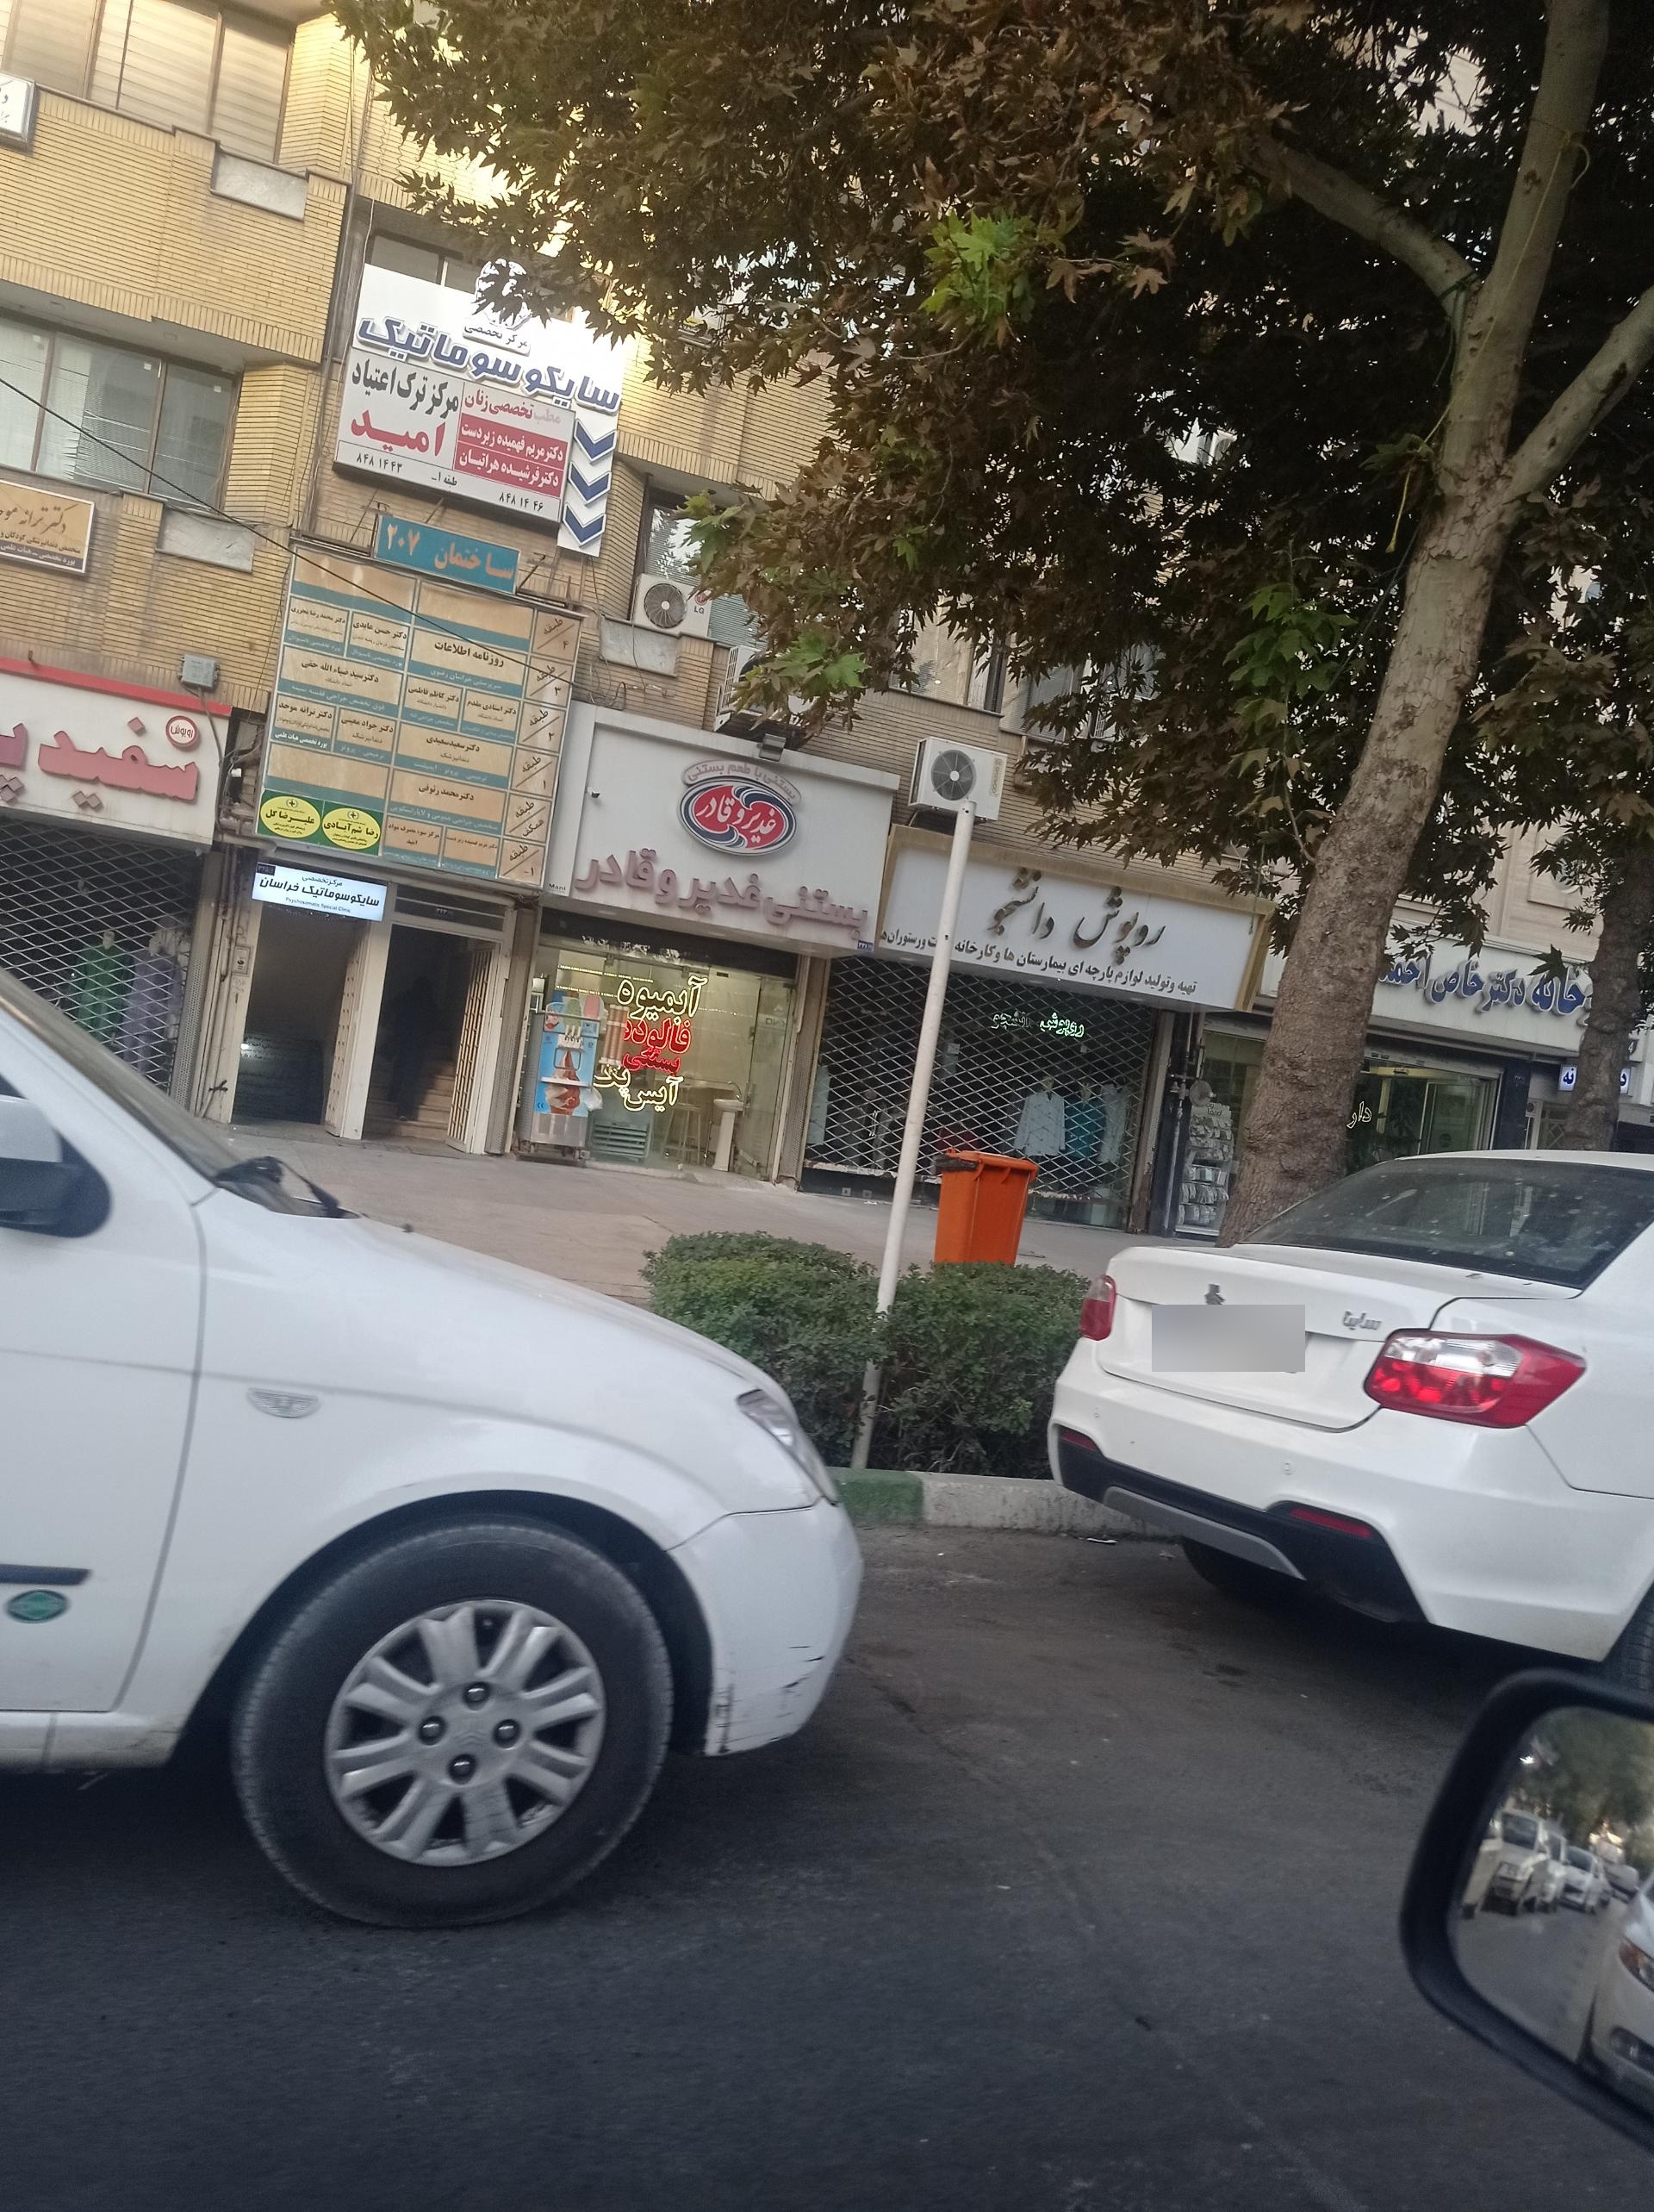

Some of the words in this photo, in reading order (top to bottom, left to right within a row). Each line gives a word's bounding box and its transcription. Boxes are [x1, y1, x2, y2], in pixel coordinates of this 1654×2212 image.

[351, 358, 397, 396] اعتیاد
[396, 371, 429, 411] ترک
[425, 381, 459, 420] مرکز
[464, 389, 489, 413] زنان
[489, 402, 534, 420] تخصصی
[351, 409, 446, 457] امید
[496, 435, 526, 454] فهمیده
[525, 443, 545, 461] مریم
[543, 445, 564, 463] دکتر
[356, 452, 375, 466] ۸۴۸
[458, 448, 501, 474] هراتیان
[443, 473, 457, 489] طبقه
[500, 462, 540, 485] فرشیده
[538, 470, 560, 488] دکتر
[499, 490, 517, 506] ۸۴۸
[18, 506, 49, 527] ترانه
[40, 503, 79, 534] دکتر
[433, 541, 514, 580] ساختمان
[693, 606, 705, 614] LG
[392, 630, 407, 640] دکتر
[543, 618, 563, 635] طبقه
[433, 640, 471, 657] اطلاعات
[320, 662, 333, 672] الله
[472, 650, 505, 668] روزنامه
[363, 674, 379, 682] دکتر
[535, 664, 556, 682] طبقه
[277, 702, 298, 713] موحد
[445, 694, 459, 703] دکتر
[299, 707, 316, 716] ترانه
[315, 711, 333, 720] دکتر
[529, 708, 549, 727] طبقه
[464, 743, 481, 752] دکتر
[521, 755, 542, 773] طبقه
[728, 758, 752, 775] طعم
[458, 792, 475, 801] دکتر
[515, 800, 535, 819] طبقه
[695, 794, 735, 823] قادر
[731, 807, 746, 826] و
[365, 826, 379, 839] رضا
[521, 819, 544, 837] همکف
[740, 807, 777, 844] غدیر
[509, 843, 529, 862] طبقه
[574, 847, 657, 892] قادر
[258, 876, 300, 892] خراسان
[302, 875, 328, 884] تخصصی
[326, 878, 344, 888] مرکز
[656, 868, 677, 905] و
[302, 885, 381, 907] سایکوسوماتیک
[677, 873, 763, 916] غدیر
[764, 885, 869, 941] بستنی
[1073, 886, 1166, 966] روپوش
[1003, 947, 1016, 963] ها
[1017, 951, 1067, 974] بیمارستان
[1067, 961, 1084, 976] ای
[1085, 964, 1114, 984] پارچه
[1114, 968, 1145, 988] لوازم
[1177, 981, 1198, 995] تهیه
[1427, 958, 1486, 1005] خاص
[1480, 969, 1527, 1013] دکتر
[617, 975, 708, 1025] آبمیوه
[623, 1016, 692, 1054] فالوده
[622, 1046, 681, 1076] بستنی
[623, 1074, 685, 1112] آیس
